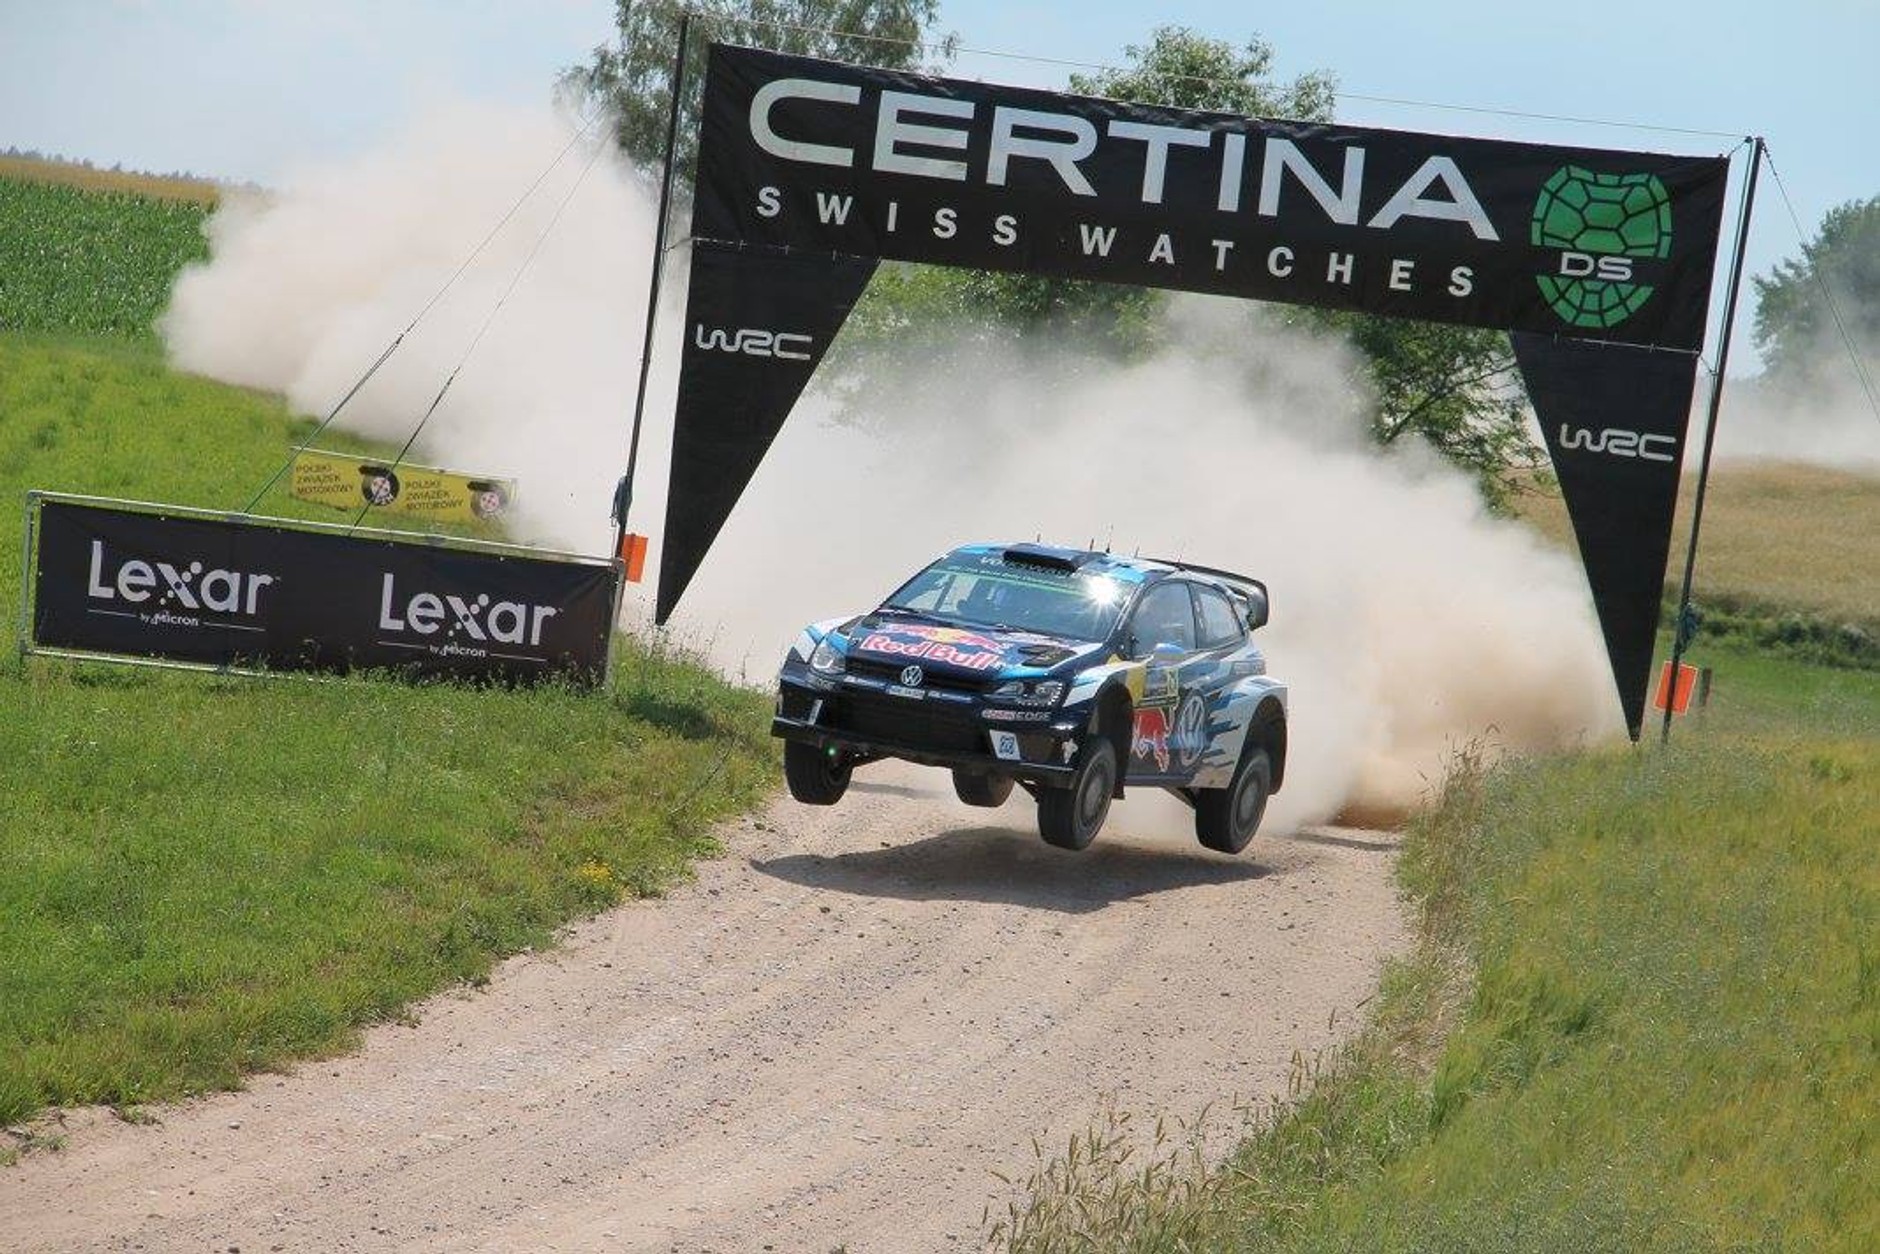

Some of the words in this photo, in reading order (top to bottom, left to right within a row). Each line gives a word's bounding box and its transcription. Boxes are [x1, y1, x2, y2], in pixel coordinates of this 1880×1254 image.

[749, 77, 1500, 241] CERTINA
[756, 186, 1018, 246] SWISS
[1079, 224, 1473, 297] WATCHES
[1560, 252, 1633, 281] DS
[695, 323, 813, 360] WRC
[1560, 422, 1677, 461] WRC
[88, 540, 274, 615] Lexar
[140, 612, 150, 623] by
[379, 573, 558, 646] Lexar
[430, 644, 439, 655] by
[859, 634, 931, 657] Red
[924, 642, 1000, 670] Bull
[1016, 711, 1052, 721] EDGE
